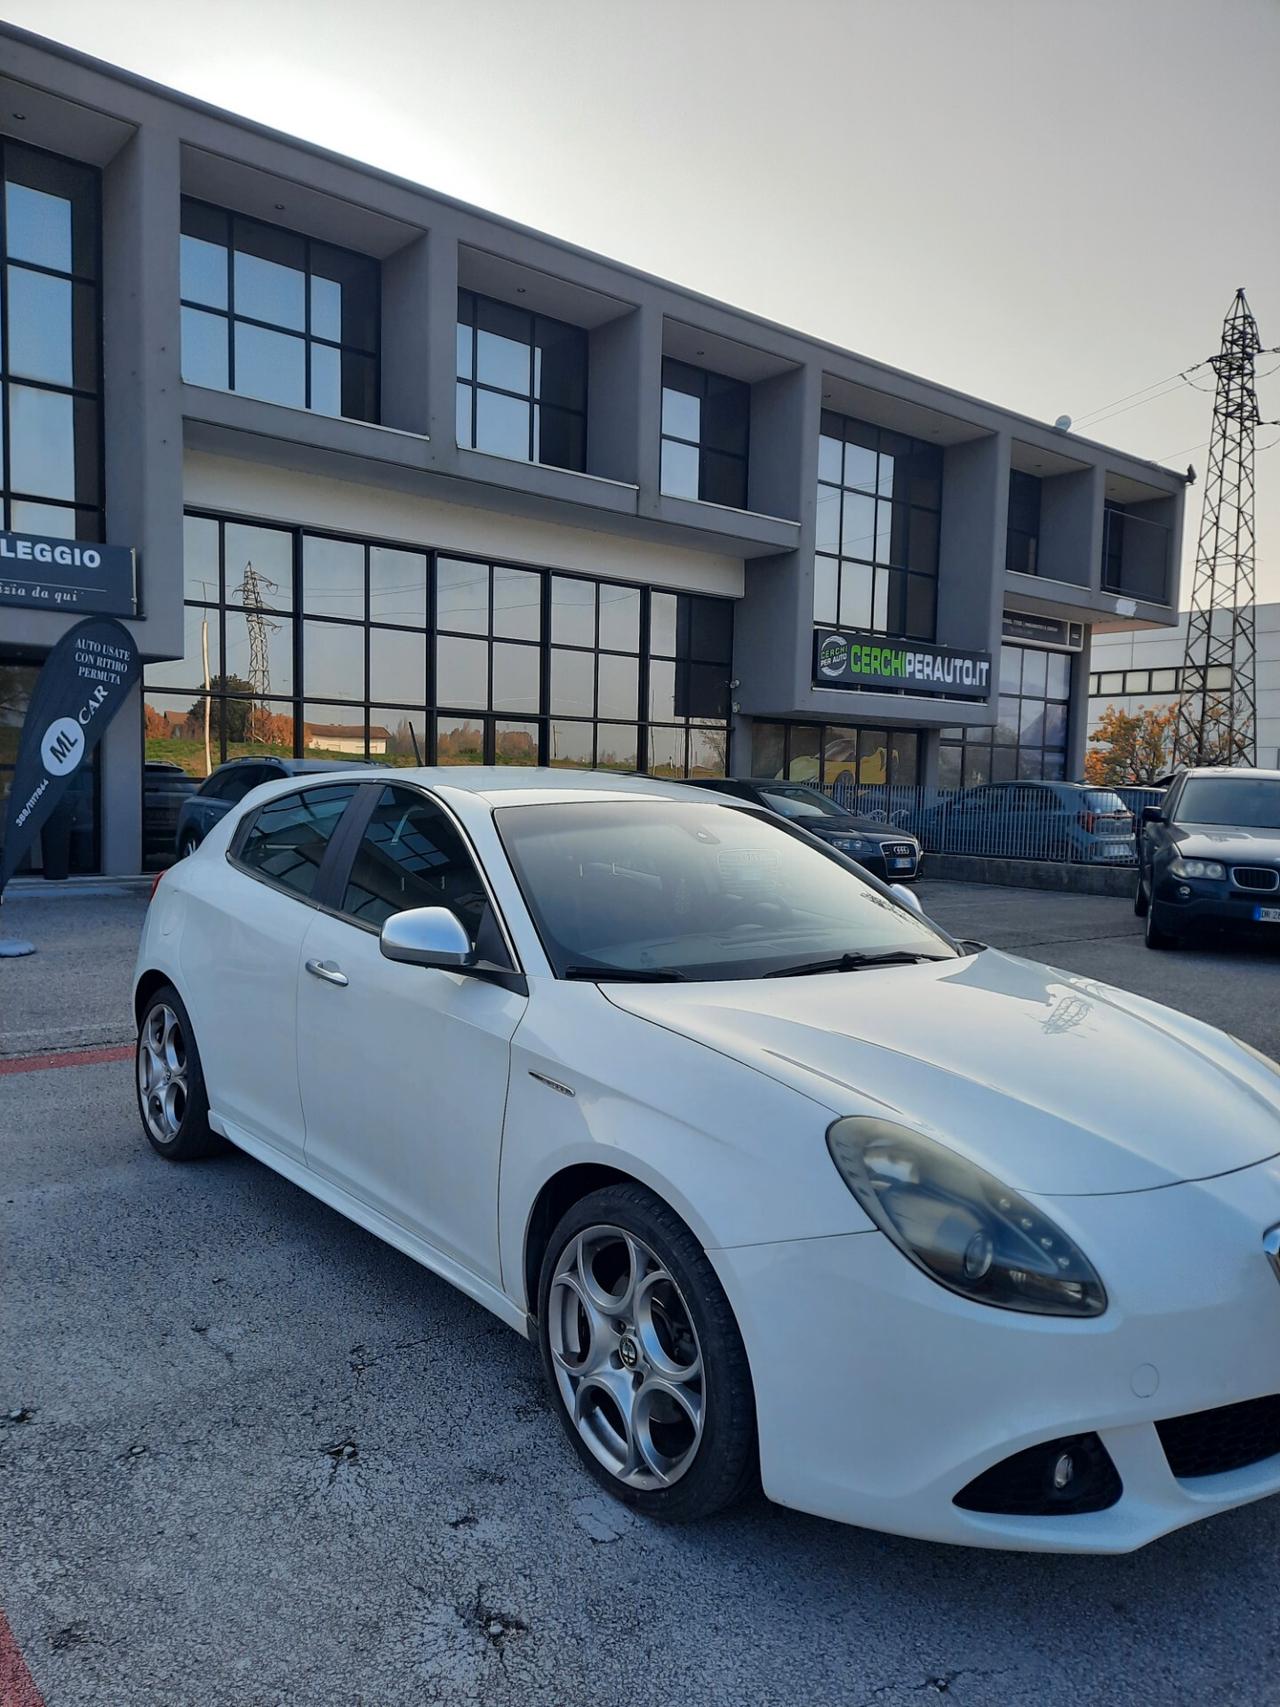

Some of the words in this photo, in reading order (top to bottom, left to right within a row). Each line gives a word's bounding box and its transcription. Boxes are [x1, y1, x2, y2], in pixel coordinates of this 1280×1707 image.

[0, 539, 101, 568] LEGGIO
[32, 586, 49, 599] da
[75, 638, 101, 652] AUTO
[102, 644, 130, 661] USATE
[821, 646, 848, 660] CERCHI
[821, 657, 832, 667] PER
[832, 653, 848, 664] AUTO
[75, 651, 95, 665] CON
[96, 656, 128, 673] RITIRO
[851, 645, 989, 686] CERCHIPERAUTO.IT
[78, 665, 121, 685] PERMUTA
[78, 685, 109, 725] CAR
[50, 731, 78, 764] ML
